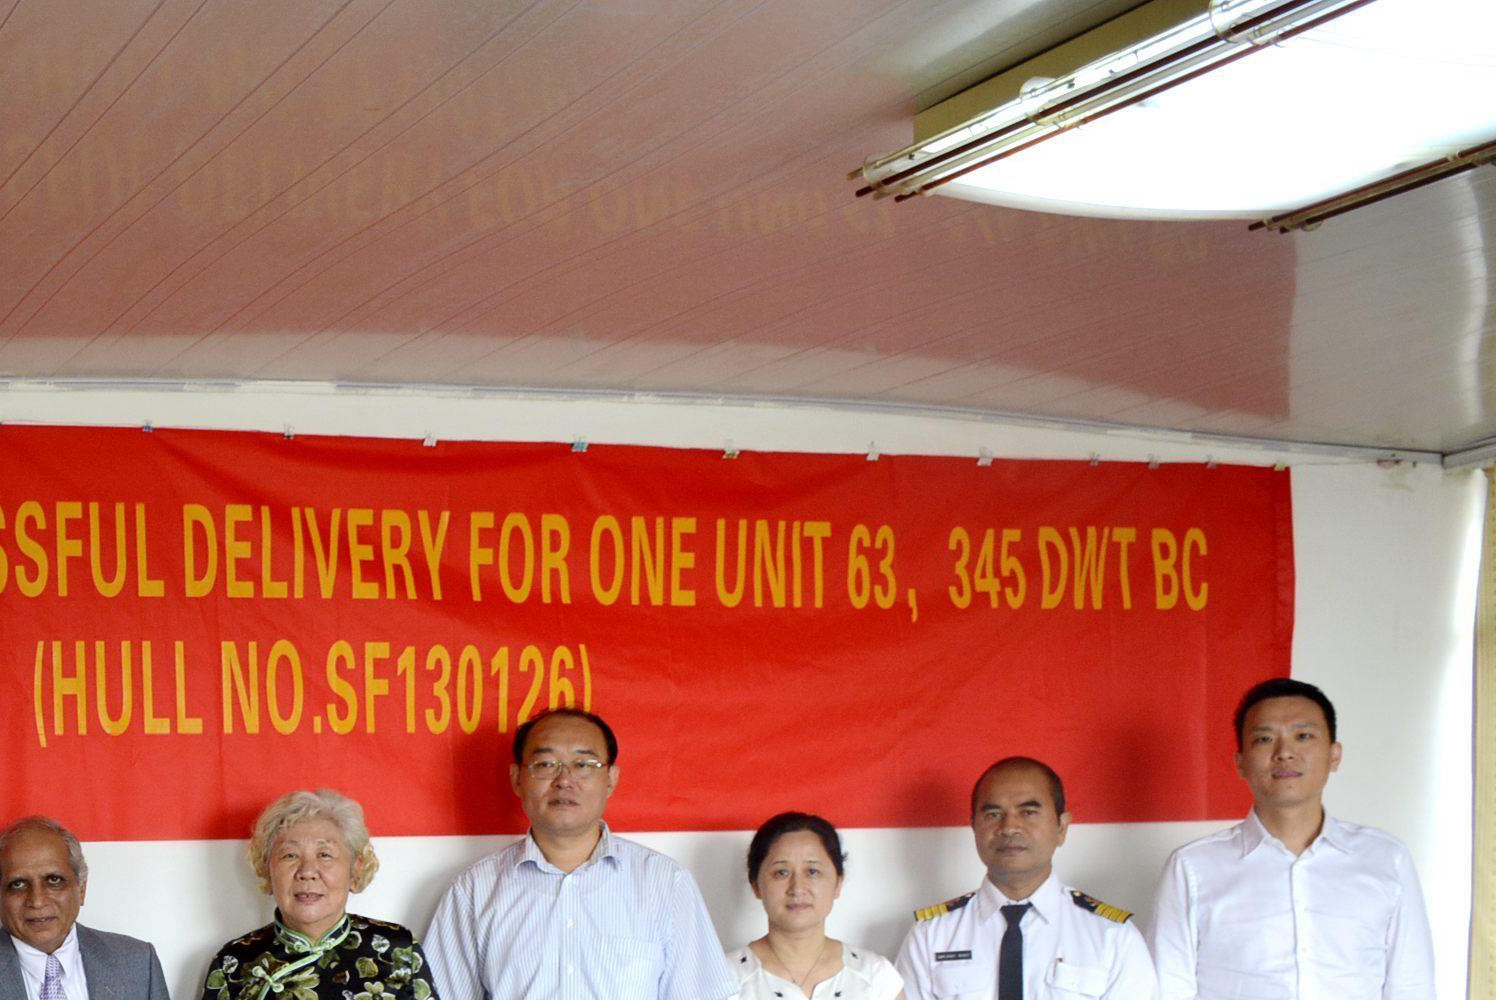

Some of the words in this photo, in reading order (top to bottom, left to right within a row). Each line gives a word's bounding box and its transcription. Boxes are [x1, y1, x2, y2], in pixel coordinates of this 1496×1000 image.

[183, 503, 450, 600] DELIVERY
[469, 511, 572, 604] FOR
[590, 515, 697, 607] ONE
[715, 518, 832, 608] UNIT
[948, 526, 1027, 609] 345
[1038, 526, 1137, 610] DWT
[1151, 527, 1209, 611] BC
[33, 640, 204, 747] (HULL
